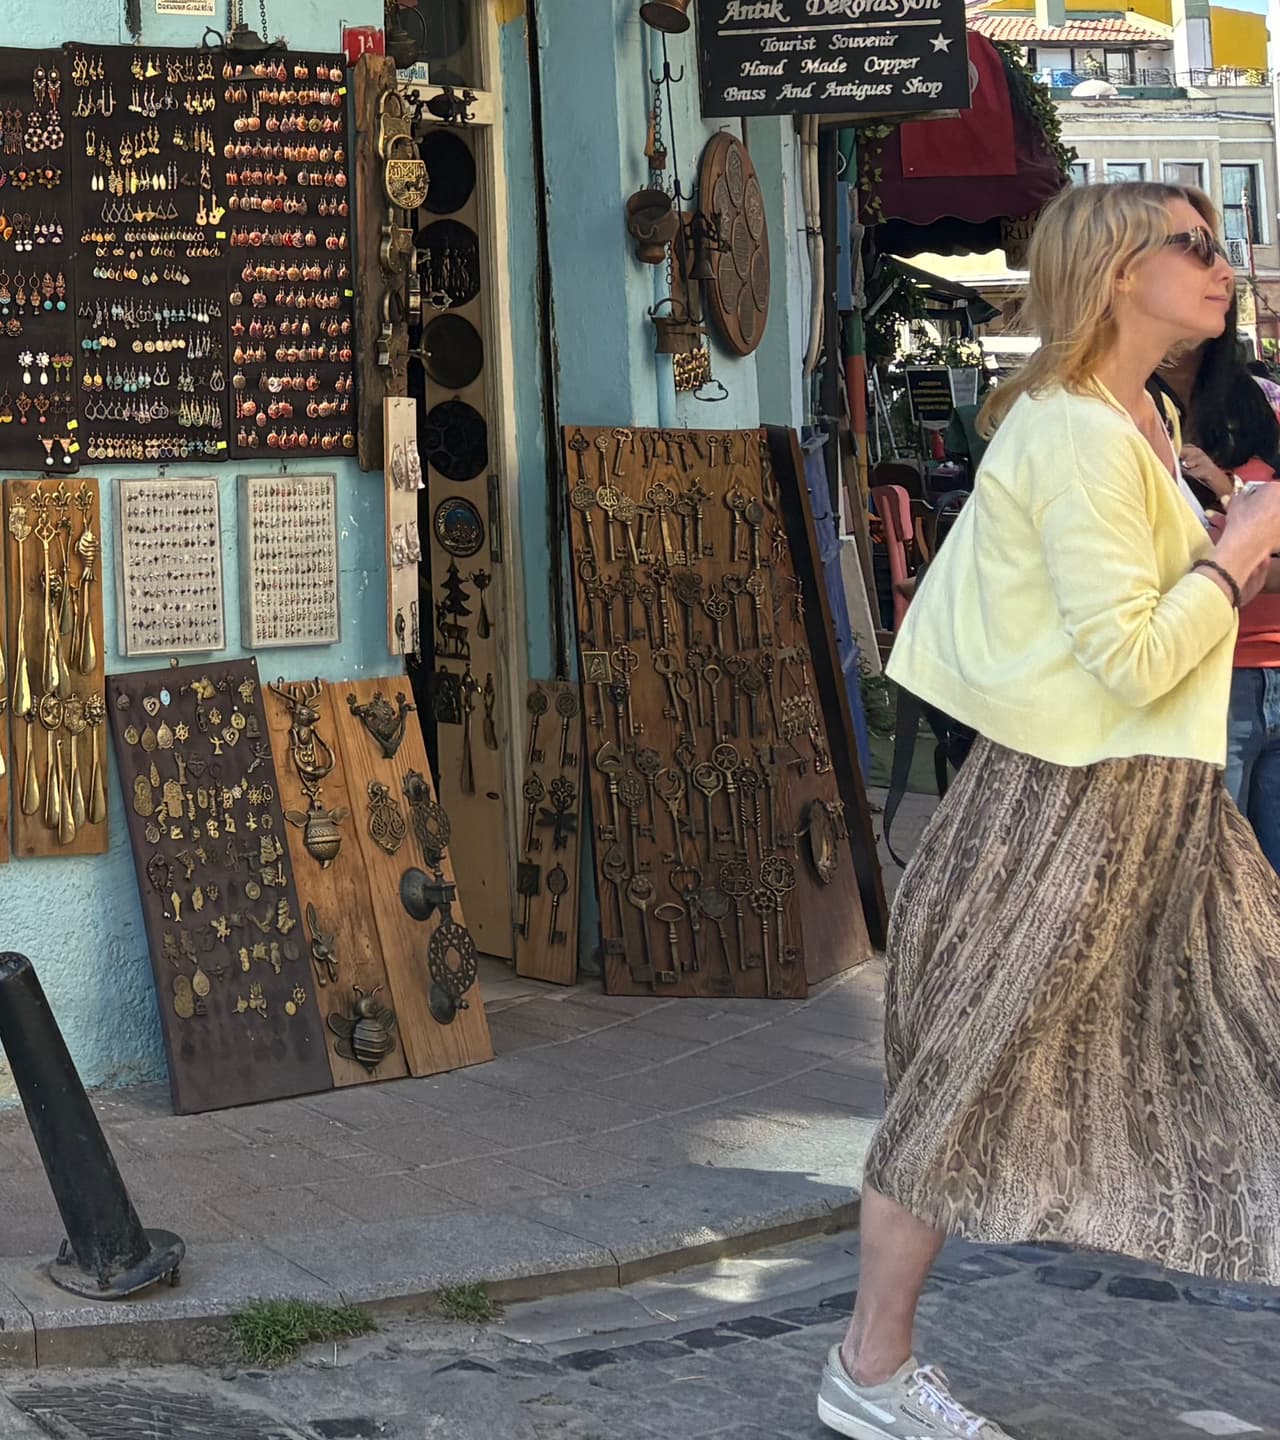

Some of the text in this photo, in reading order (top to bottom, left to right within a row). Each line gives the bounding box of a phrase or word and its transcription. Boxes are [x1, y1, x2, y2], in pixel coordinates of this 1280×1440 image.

[760, 30, 899, 53] Tourist Souvenir
[739, 55, 920, 77] Hand Made Copper
[723, 86, 766, 102] Brass
[775, 81, 817, 100] And
[901, 76, 943, 98] Shop
